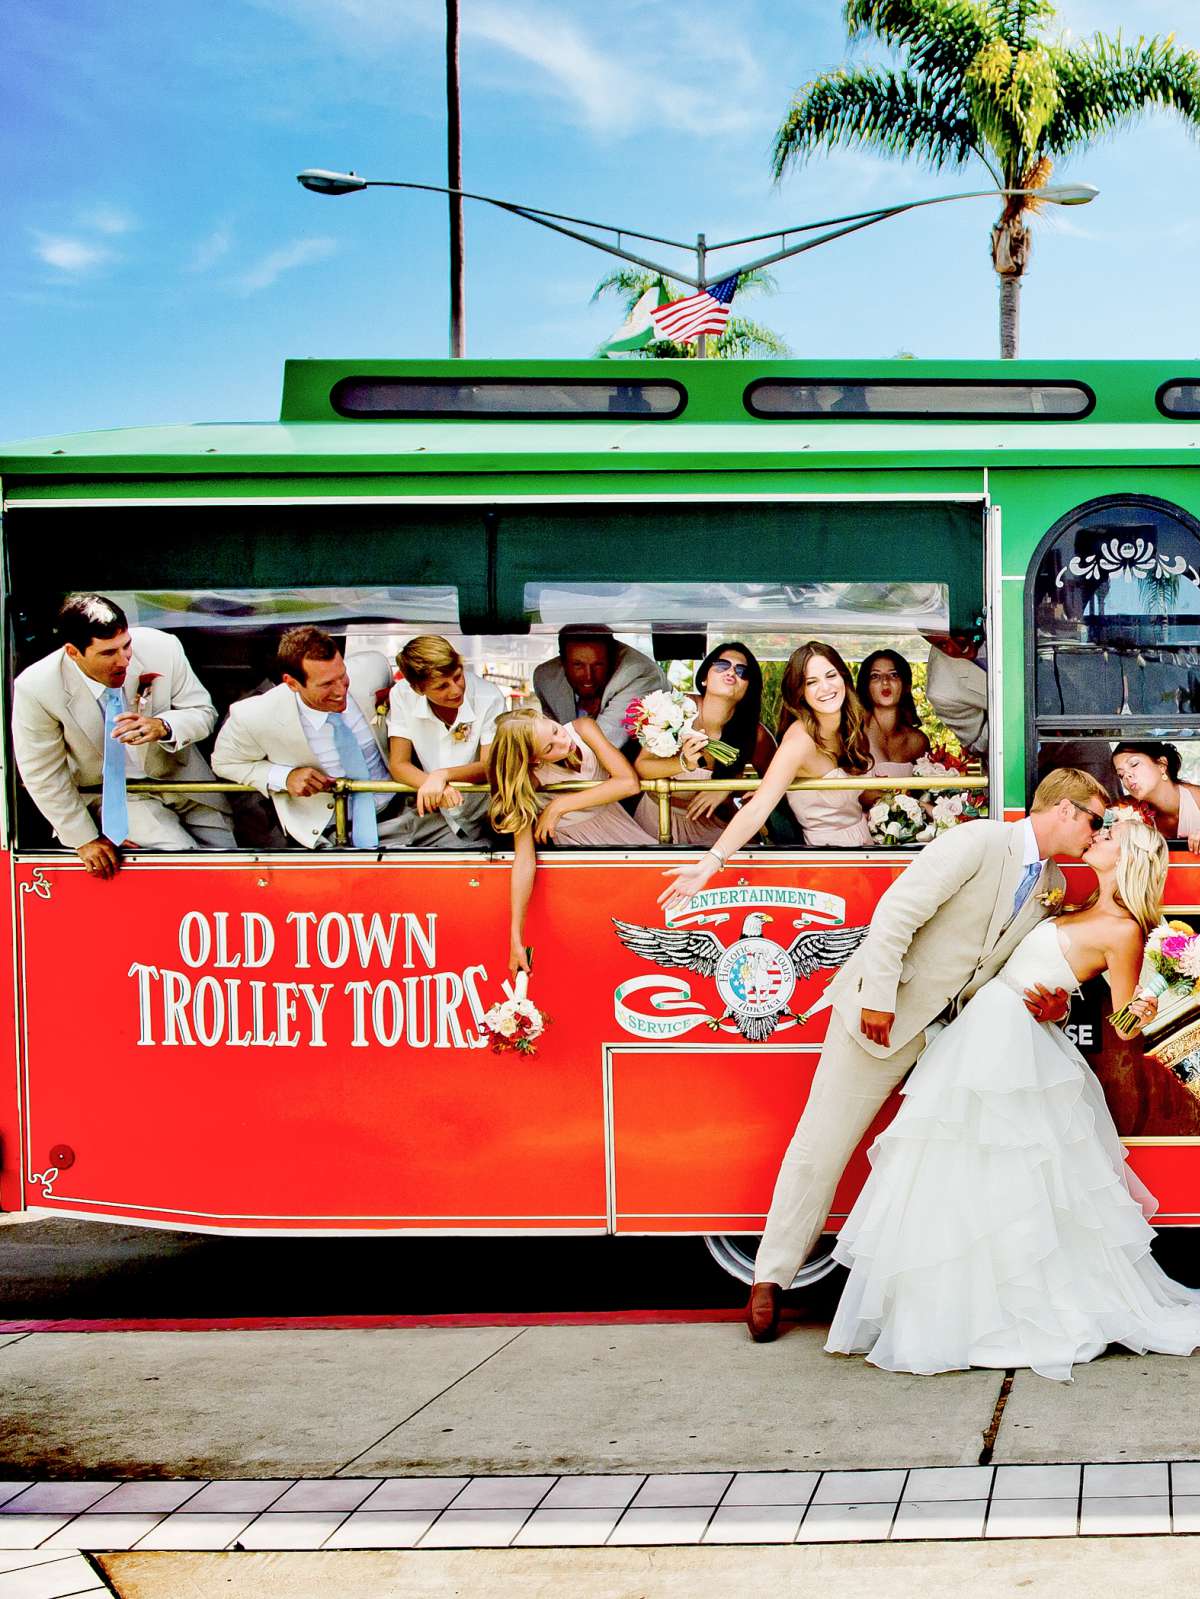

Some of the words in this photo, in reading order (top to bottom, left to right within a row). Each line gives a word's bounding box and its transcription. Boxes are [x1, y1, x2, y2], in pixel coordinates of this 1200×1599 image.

[691, 889, 816, 909] ENTERTAINMENT
[179, 911, 275, 968] OLD
[286, 911, 438, 968] TOWN
[719, 944, 752, 982] Historic
[128, 962, 334, 1048] TROLLEY
[344, 964, 489, 1049] TOURS
[628, 1015, 690, 1033] SERVICE
